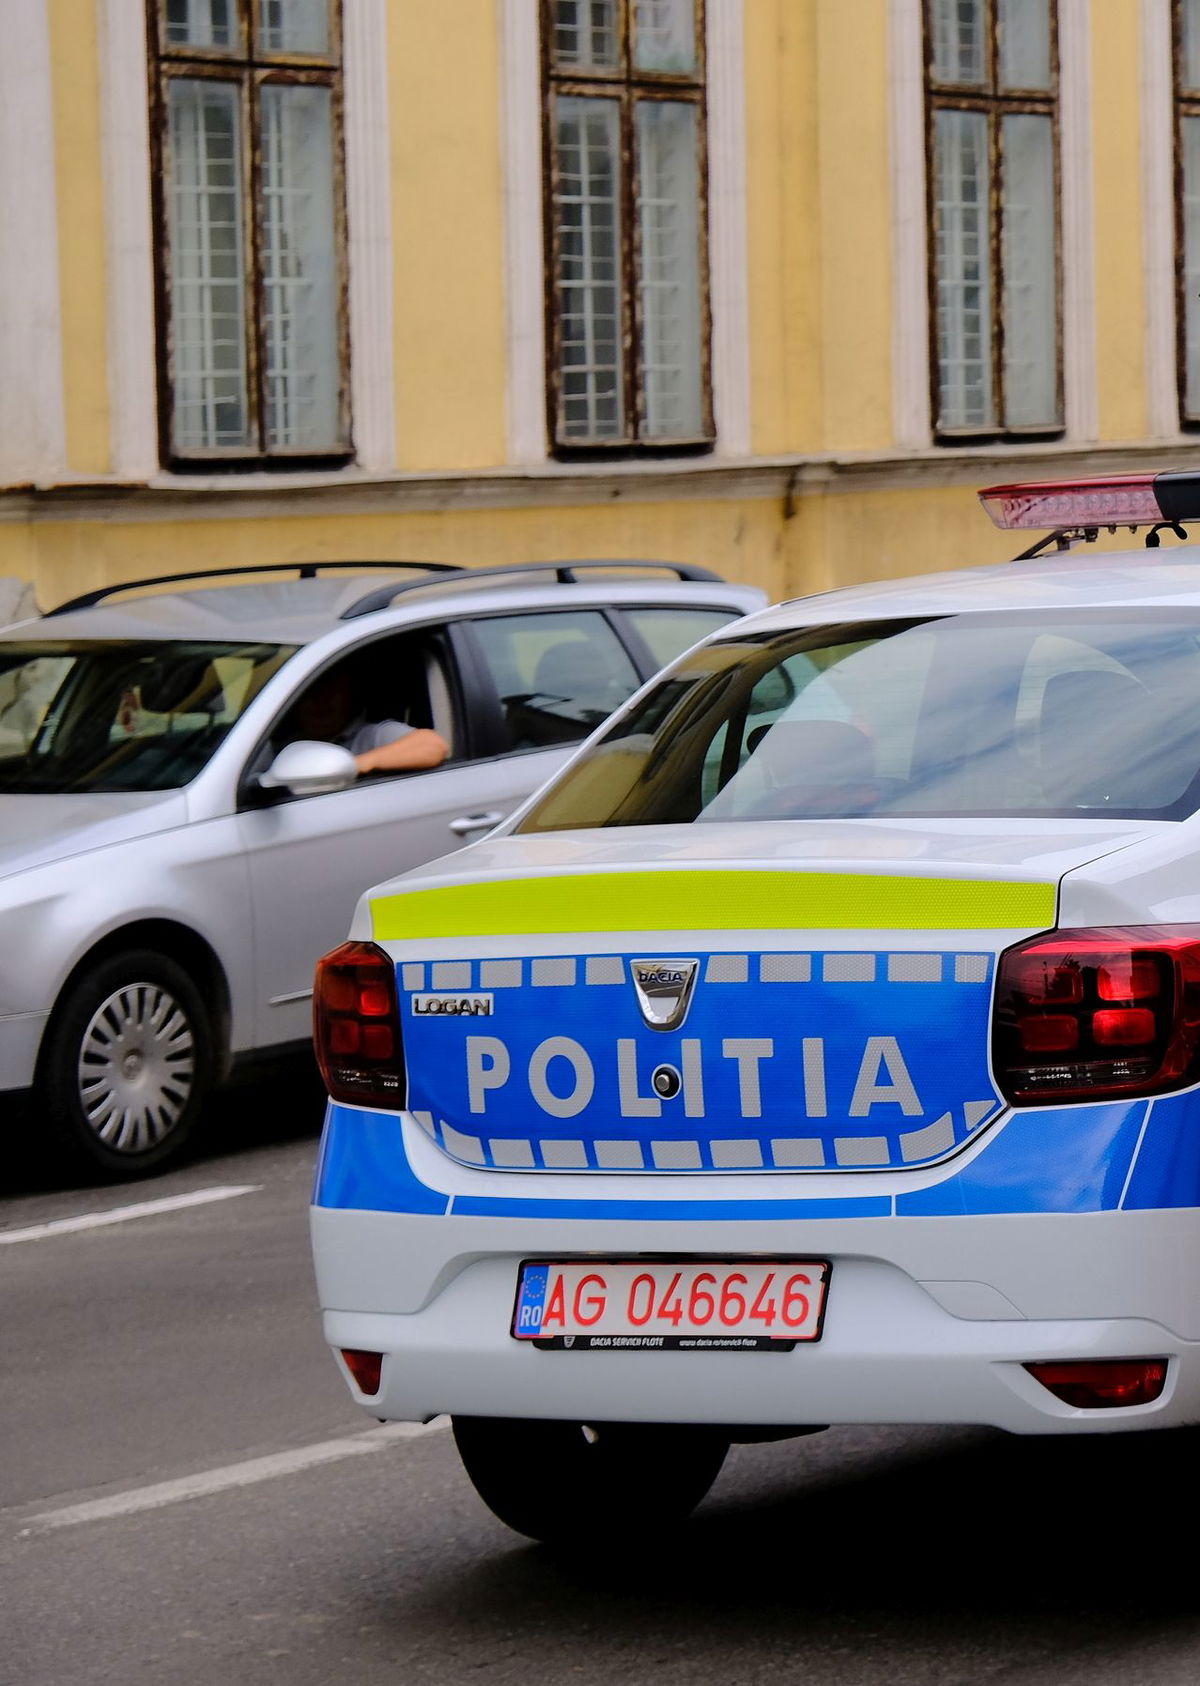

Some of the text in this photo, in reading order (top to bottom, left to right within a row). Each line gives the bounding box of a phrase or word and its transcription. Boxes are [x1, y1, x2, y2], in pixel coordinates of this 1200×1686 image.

[638, 972, 684, 983] DACIA
[414, 998, 491, 1016] LOGAN
[465, 1035, 925, 1118] POLITIA
[541, 1272, 812, 1327] AG 046646
[519, 1304, 542, 1327] RO
[590, 1337, 611, 1347] DACIA
[642, 1337, 664, 1347] FLOTE
